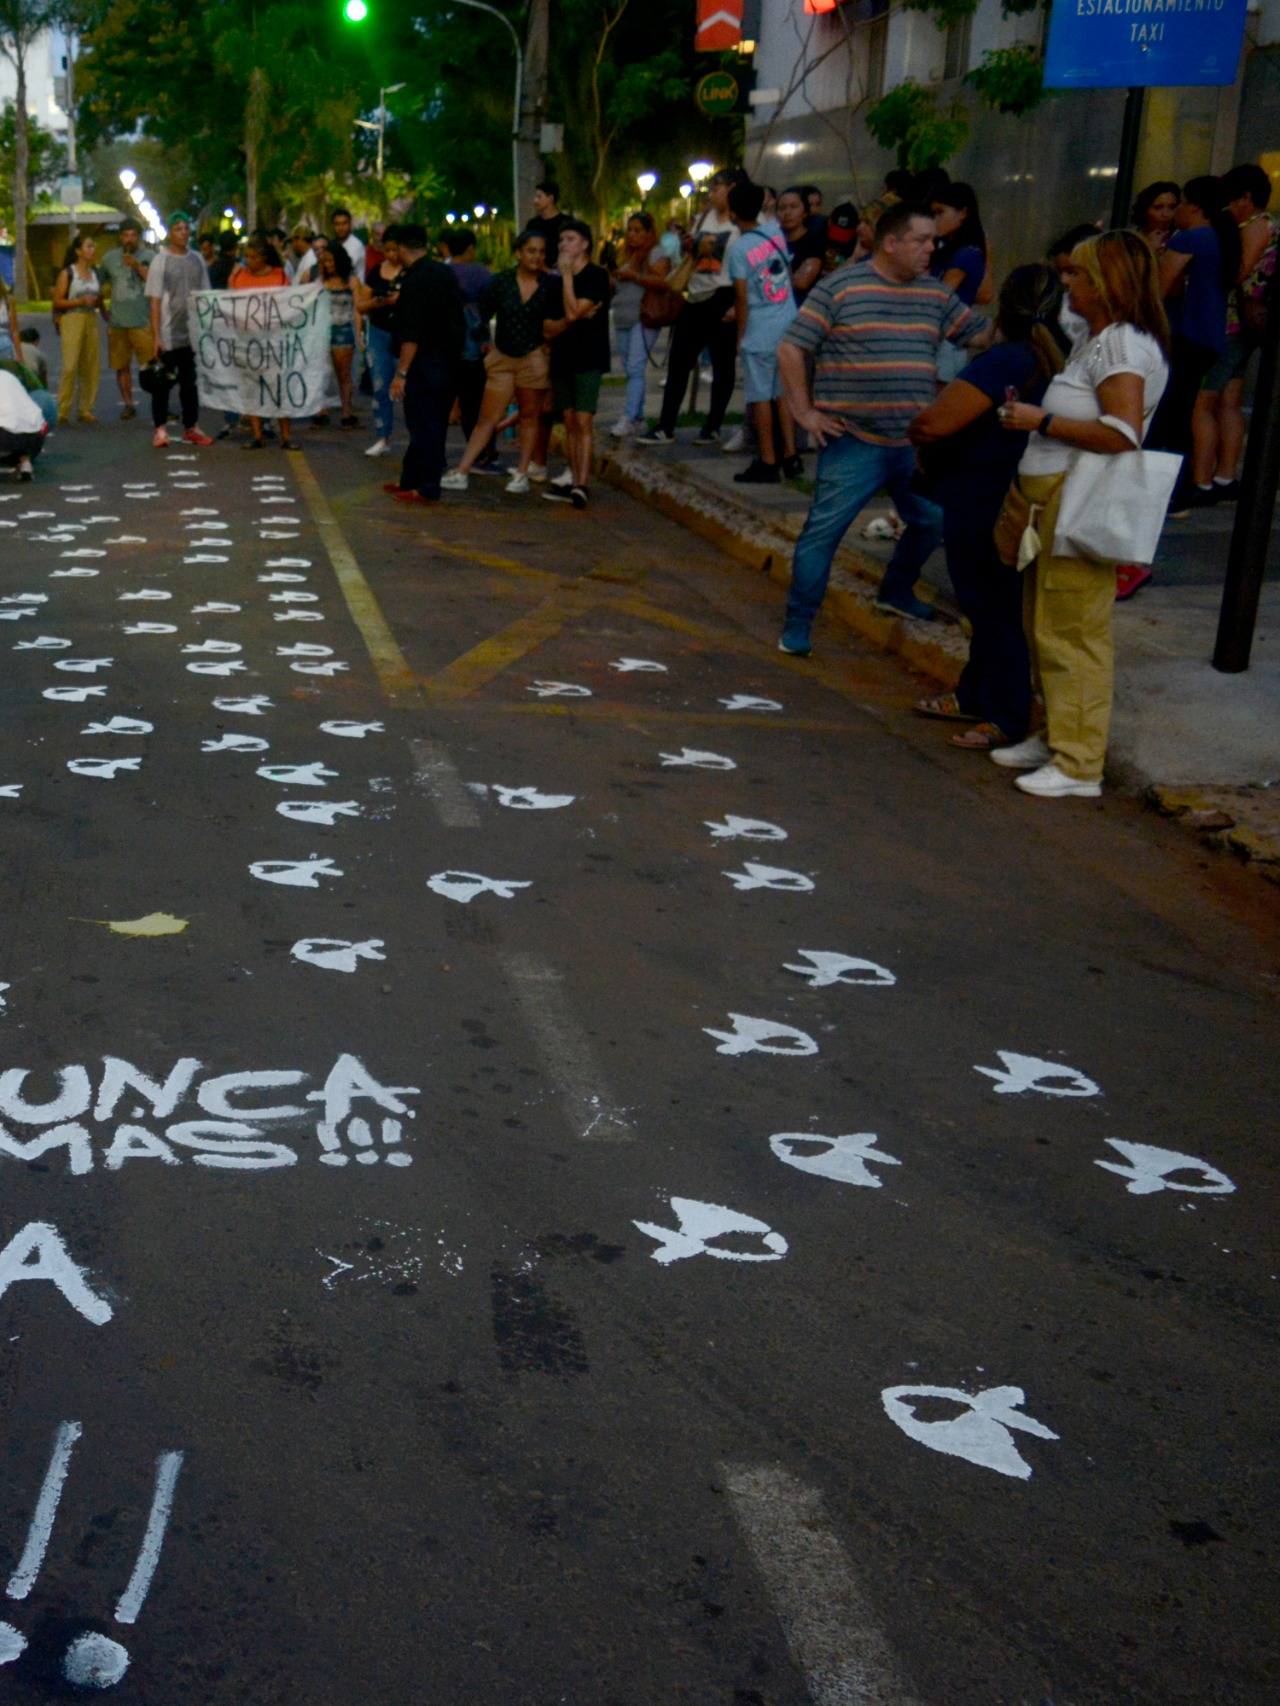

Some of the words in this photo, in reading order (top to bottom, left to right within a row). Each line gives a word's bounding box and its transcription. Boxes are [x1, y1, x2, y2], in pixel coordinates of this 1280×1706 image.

[1077, 0, 1224, 15] ESTACIONAMIENTO
[1130, 23, 1165, 42] TAXI
[259, 371, 308, 408] NO
